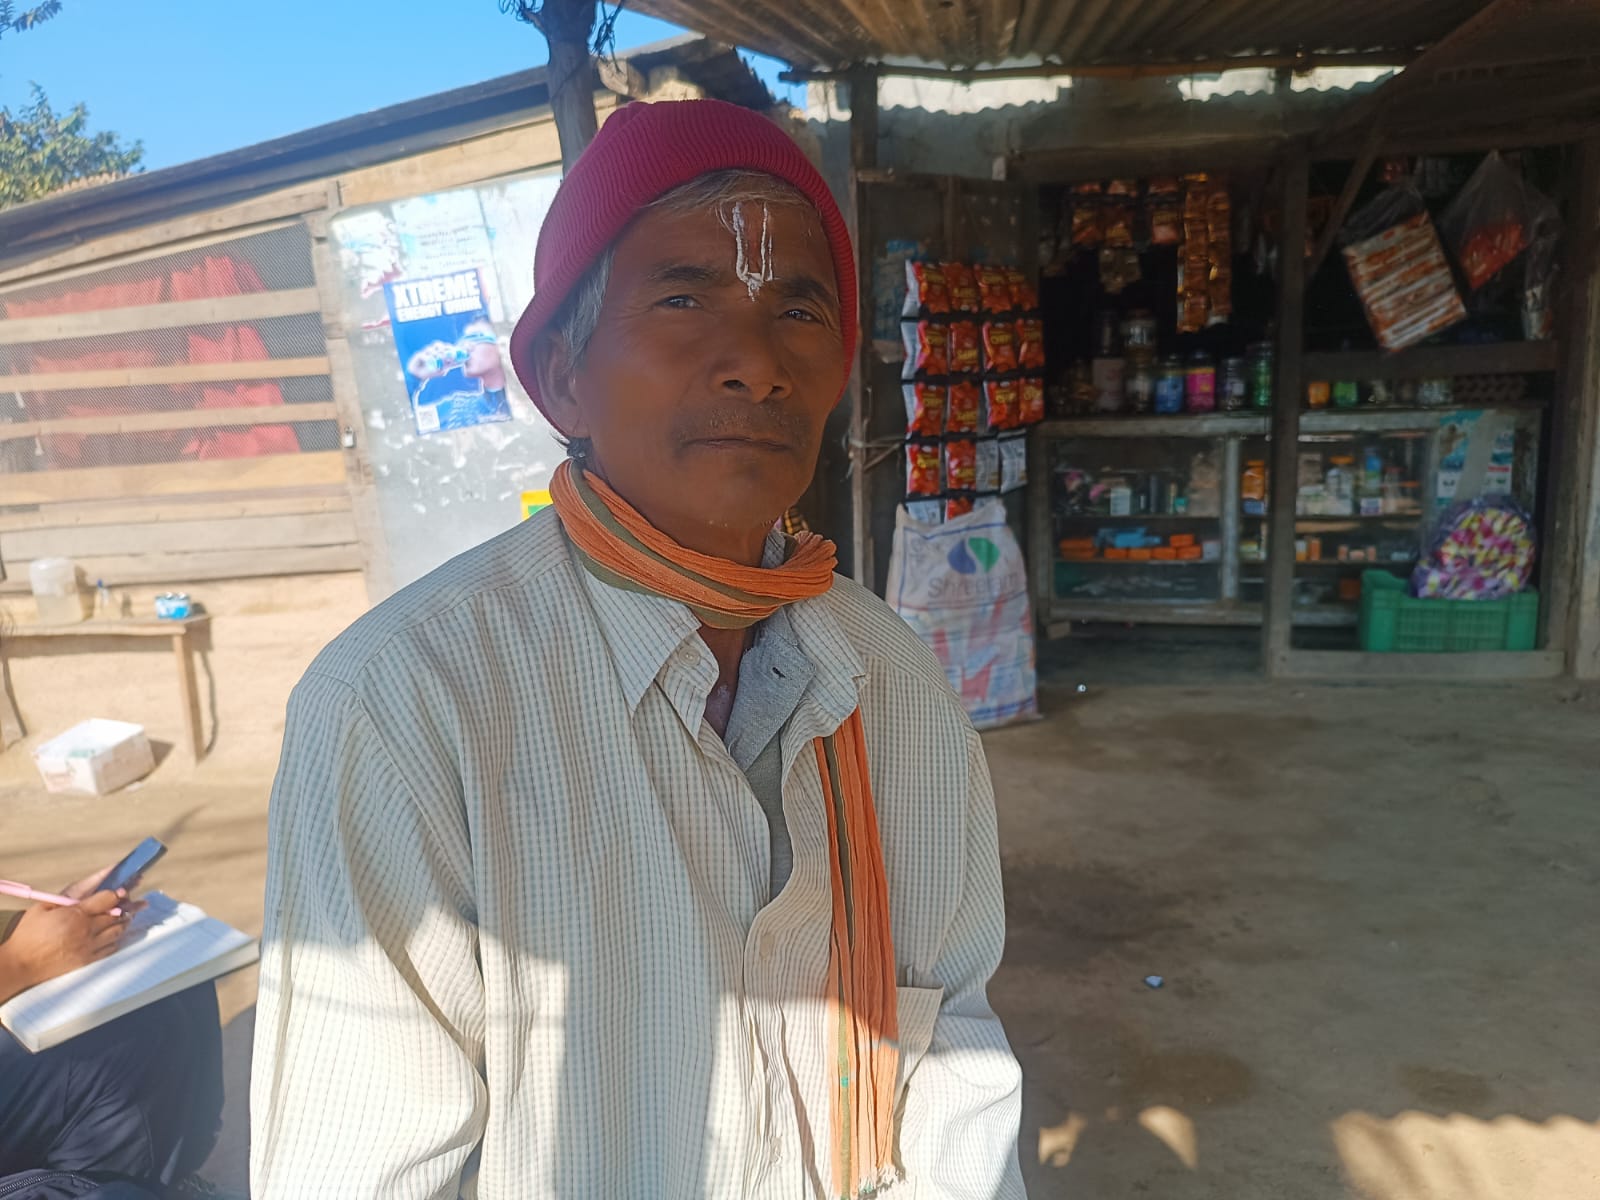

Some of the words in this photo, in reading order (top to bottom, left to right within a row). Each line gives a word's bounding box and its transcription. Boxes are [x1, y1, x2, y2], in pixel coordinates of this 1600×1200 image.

[392, 271, 480, 309] XTREME
[396, 302, 442, 322] ENERGY
[443, 296, 482, 315] DRINK
